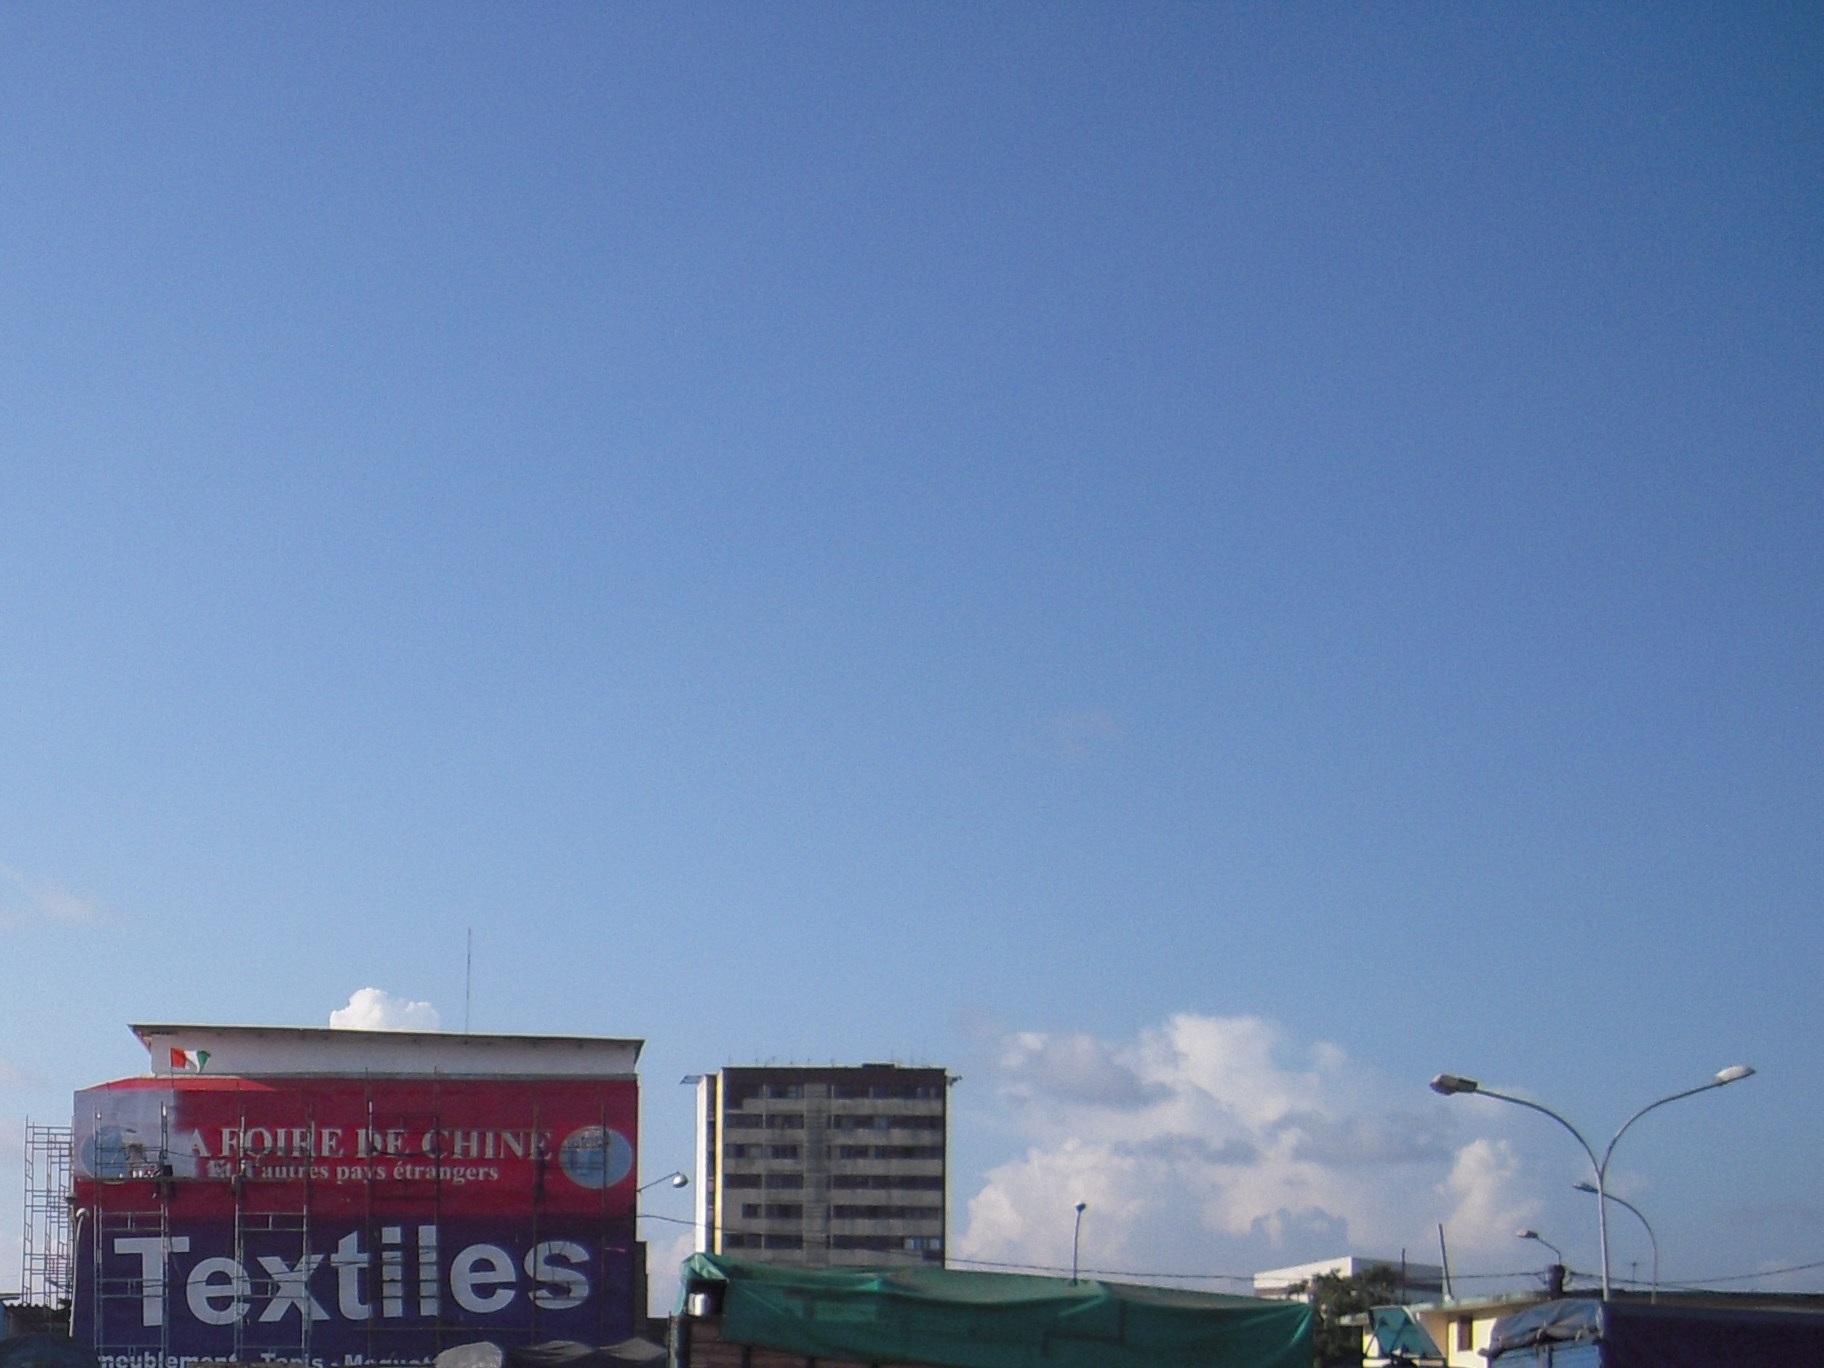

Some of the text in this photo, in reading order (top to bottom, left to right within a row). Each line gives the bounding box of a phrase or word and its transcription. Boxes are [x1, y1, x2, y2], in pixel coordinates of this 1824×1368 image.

[222, 1127, 345, 1159] FOIRE
[357, 1129, 409, 1160] DE
[421, 1129, 553, 1161] CHINE
[336, 1166, 386, 1185] pays
[393, 1161, 499, 1184] étrangers
[113, 1225, 592, 1327] Textiles
